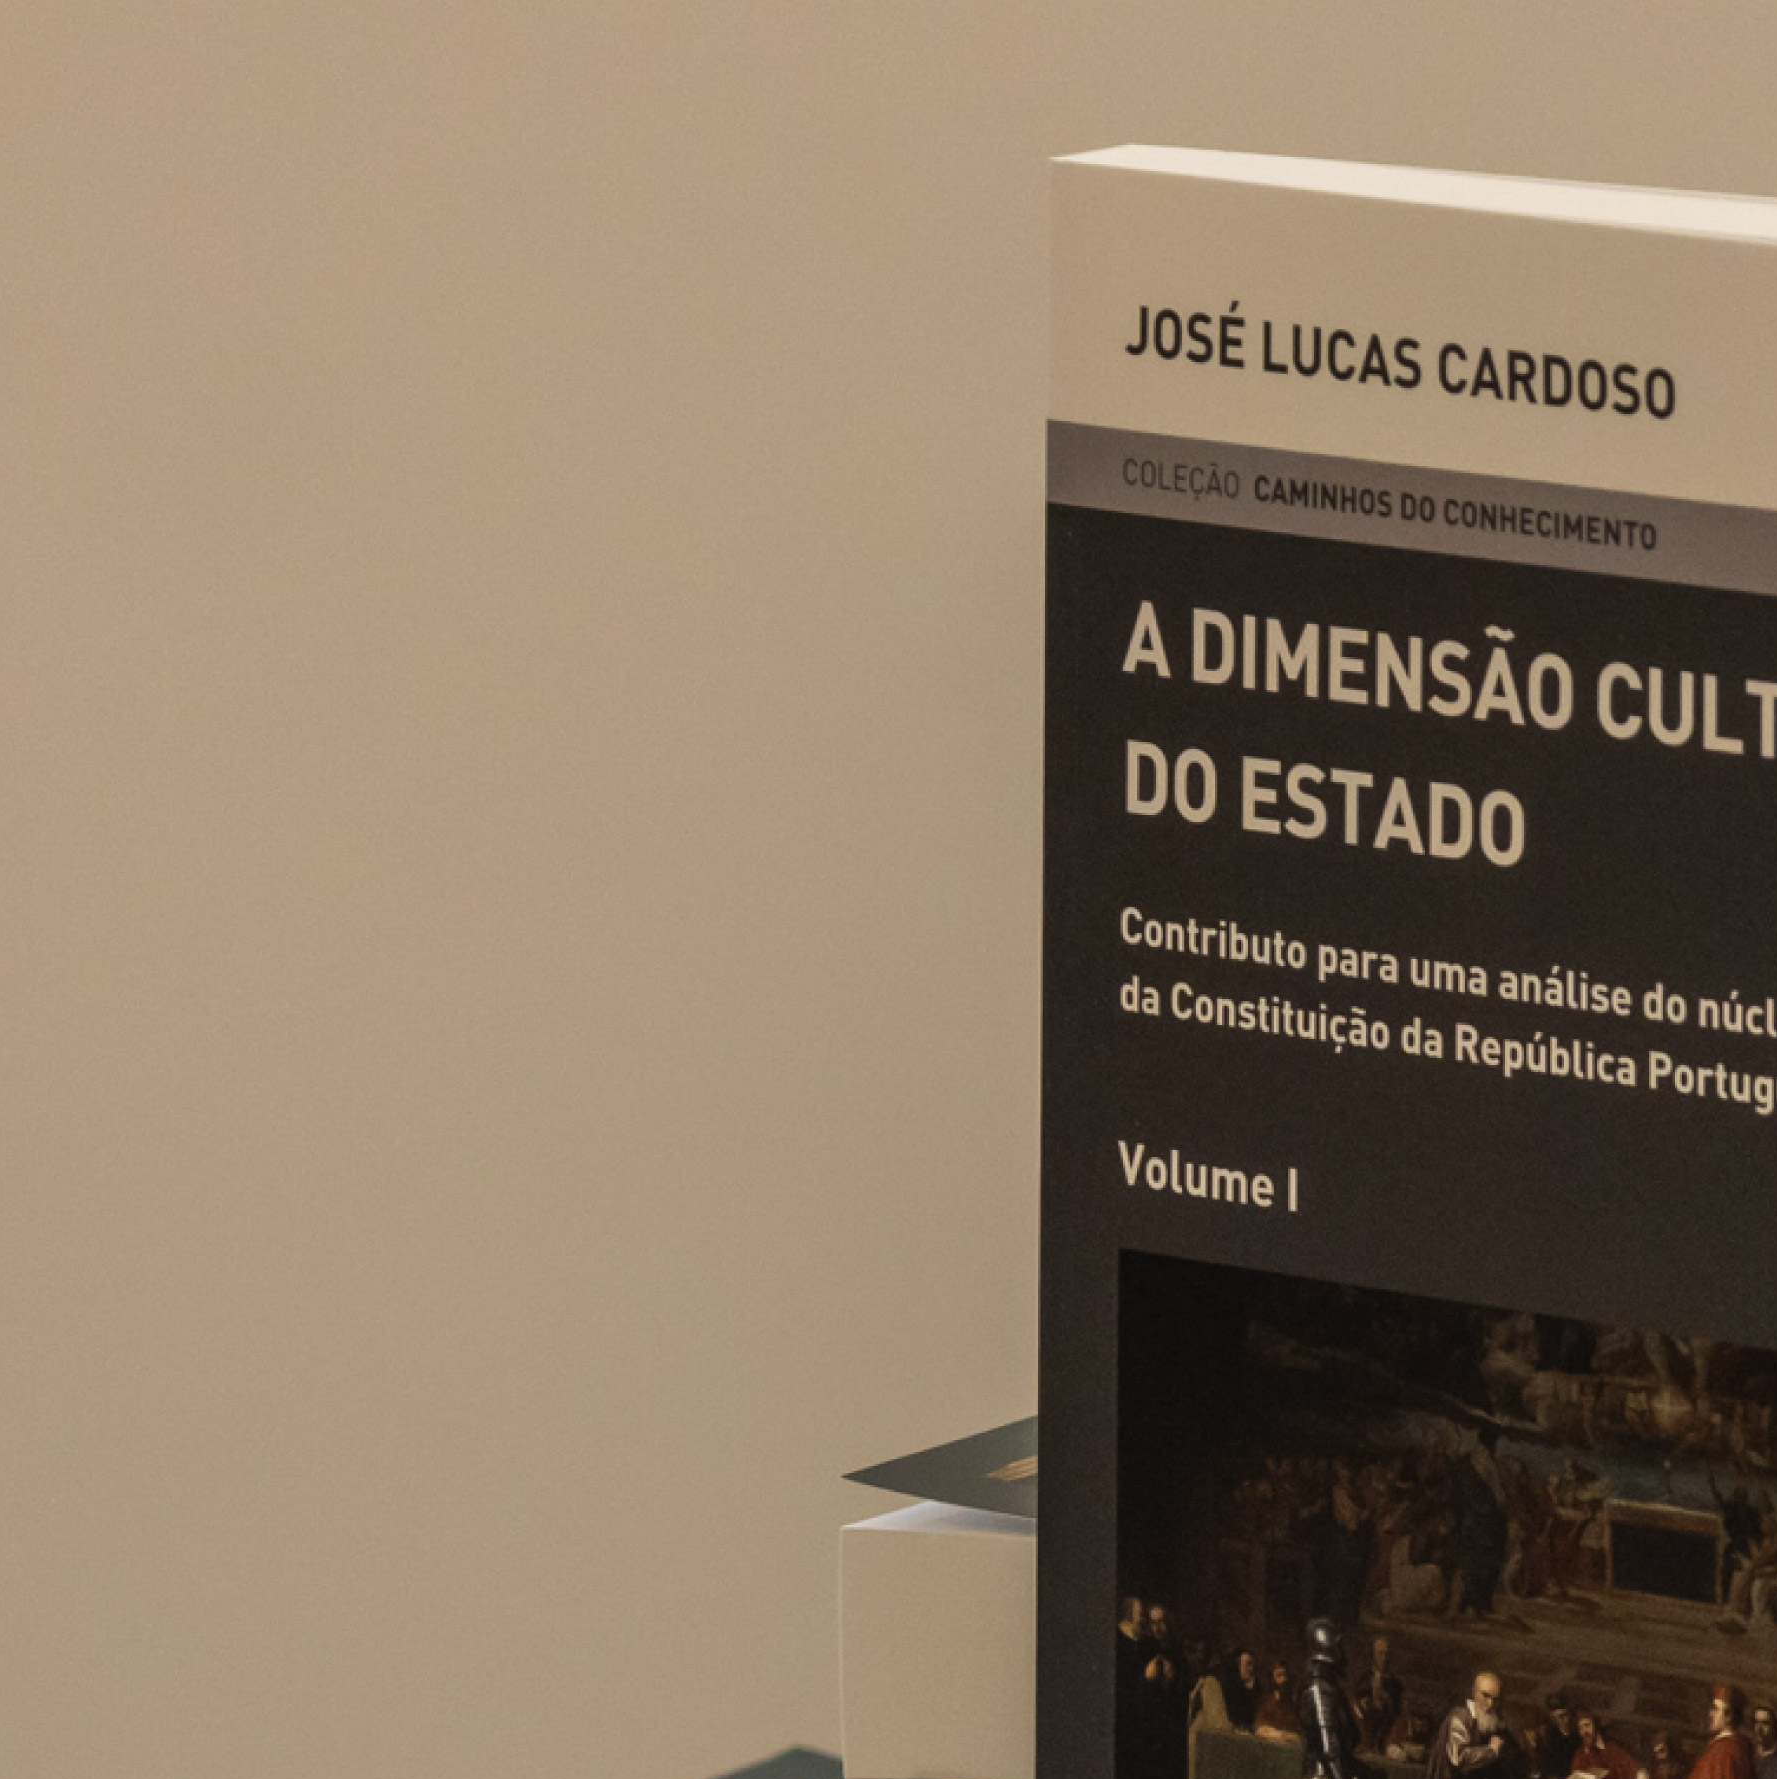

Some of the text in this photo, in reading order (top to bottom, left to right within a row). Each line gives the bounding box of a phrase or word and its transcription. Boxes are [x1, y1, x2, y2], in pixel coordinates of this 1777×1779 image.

[1126, 301, 1676, 419] JOSÉ LUCAS CARDOSO
[1122, 457, 1657, 551] COLEÇÃO CAMINHOS DO CONHECIMENTO
[1122, 600, 1171, 679] A
[1191, 606, 1572, 730] DIMENSÃO
[1125, 740, 1525, 868] DO ESTADO
[1121, 906, 1306, 970] Contributo
[1318, 936, 1399, 984] para
[1410, 953, 1487, 999] uma
[1499, 964, 1631, 1018] análise
[1642, 982, 1686, 1025] do
[1121, 975, 1161, 1018] da
[1171, 983, 1391, 1055] Constituição
[1401, 1016, 1443, 1059] da
[1455, 1023, 1637, 1086] República
[1118, 1139, 1298, 1211] Volume I
